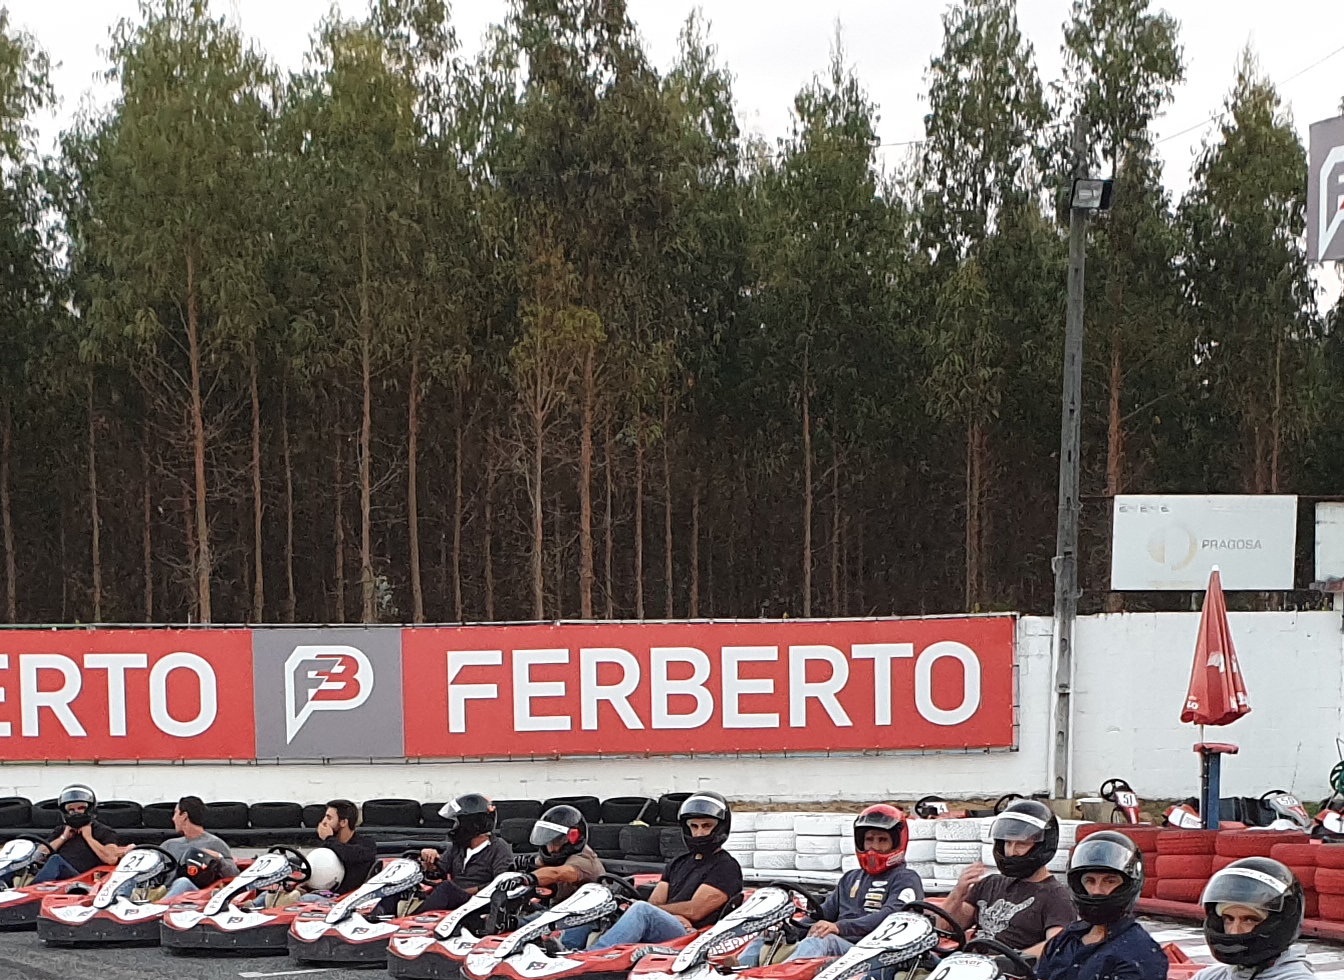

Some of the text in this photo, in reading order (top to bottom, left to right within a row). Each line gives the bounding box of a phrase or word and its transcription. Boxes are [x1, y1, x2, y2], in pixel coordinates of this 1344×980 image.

[1201, 539, 1262, 550] PRAGOSA
[447, 641, 982, 733] FERBERTO
[872, 921, 908, 941] 32
